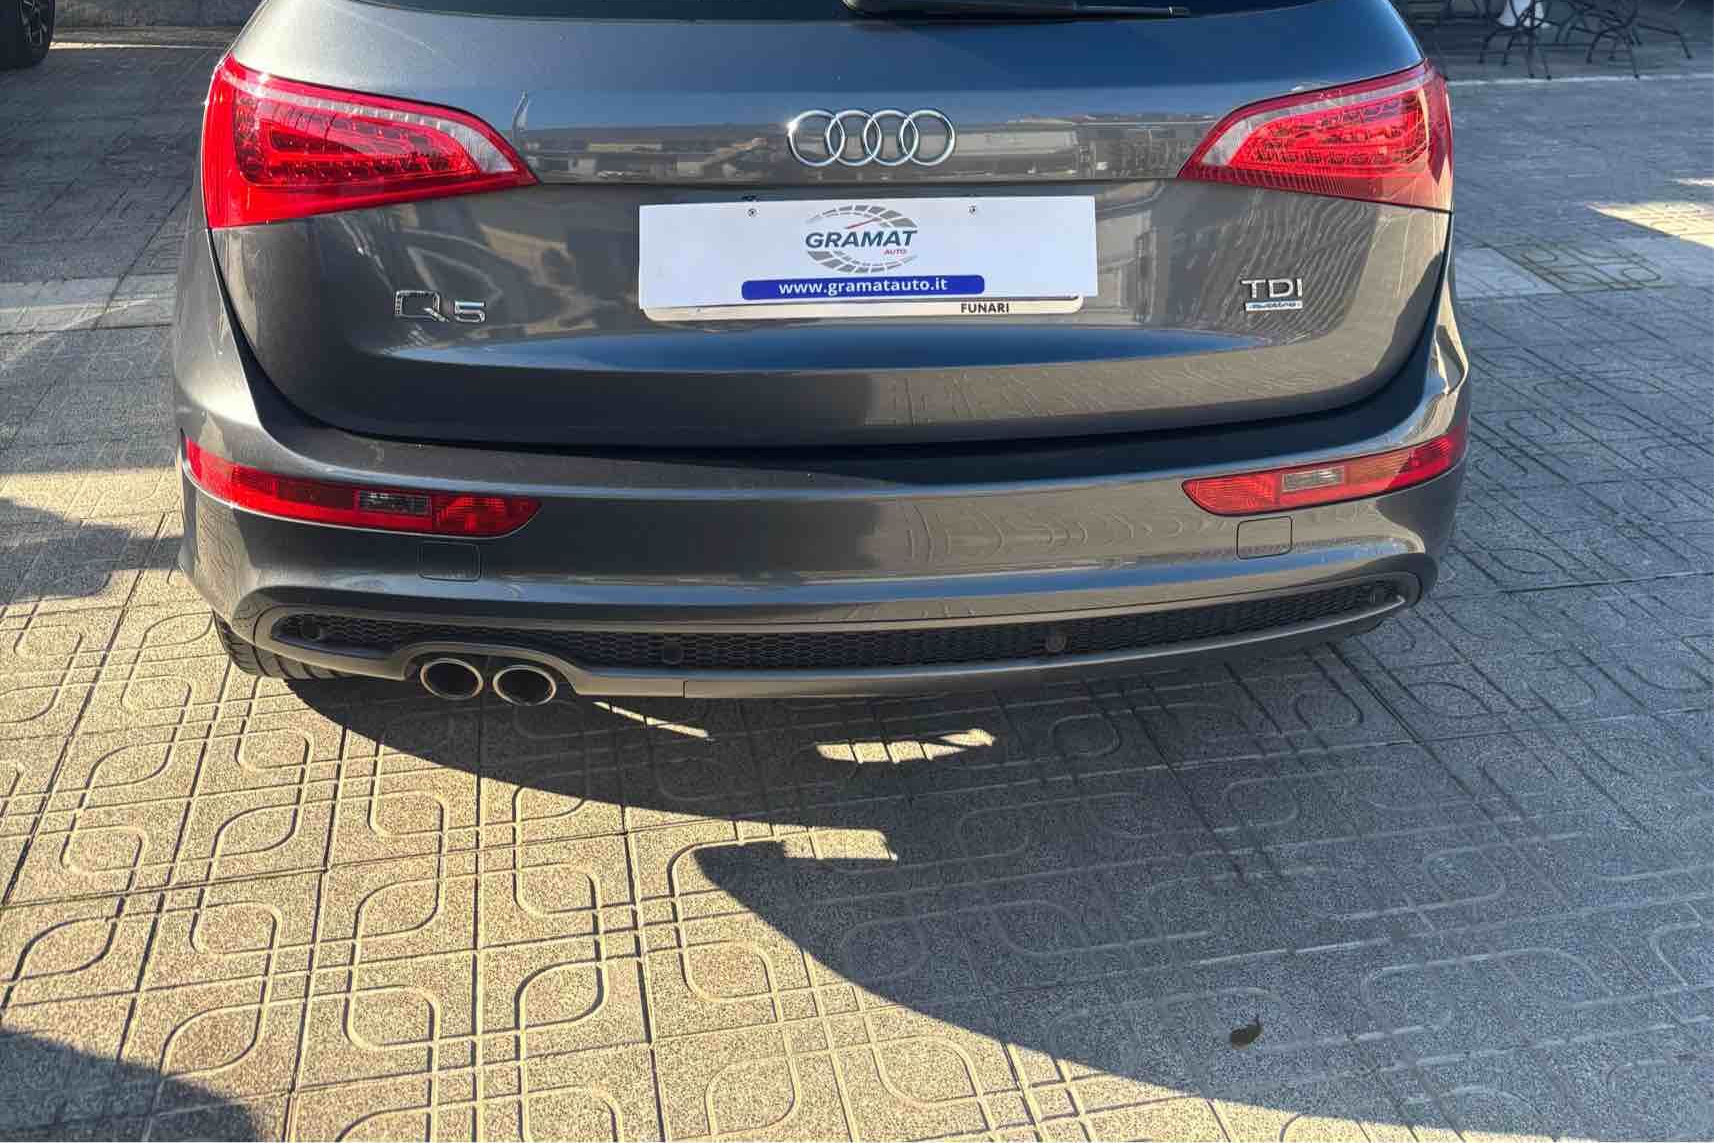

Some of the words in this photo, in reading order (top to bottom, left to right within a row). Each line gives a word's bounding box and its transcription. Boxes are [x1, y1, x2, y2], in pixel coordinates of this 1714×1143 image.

[805, 230, 918, 249] GRAMAT
[778, 276, 949, 296] www.gramatauto.it
[1240, 278, 1303, 298] TDI
[395, 290, 486, 323] Q5
[960, 302, 1010, 314] FUNARI
